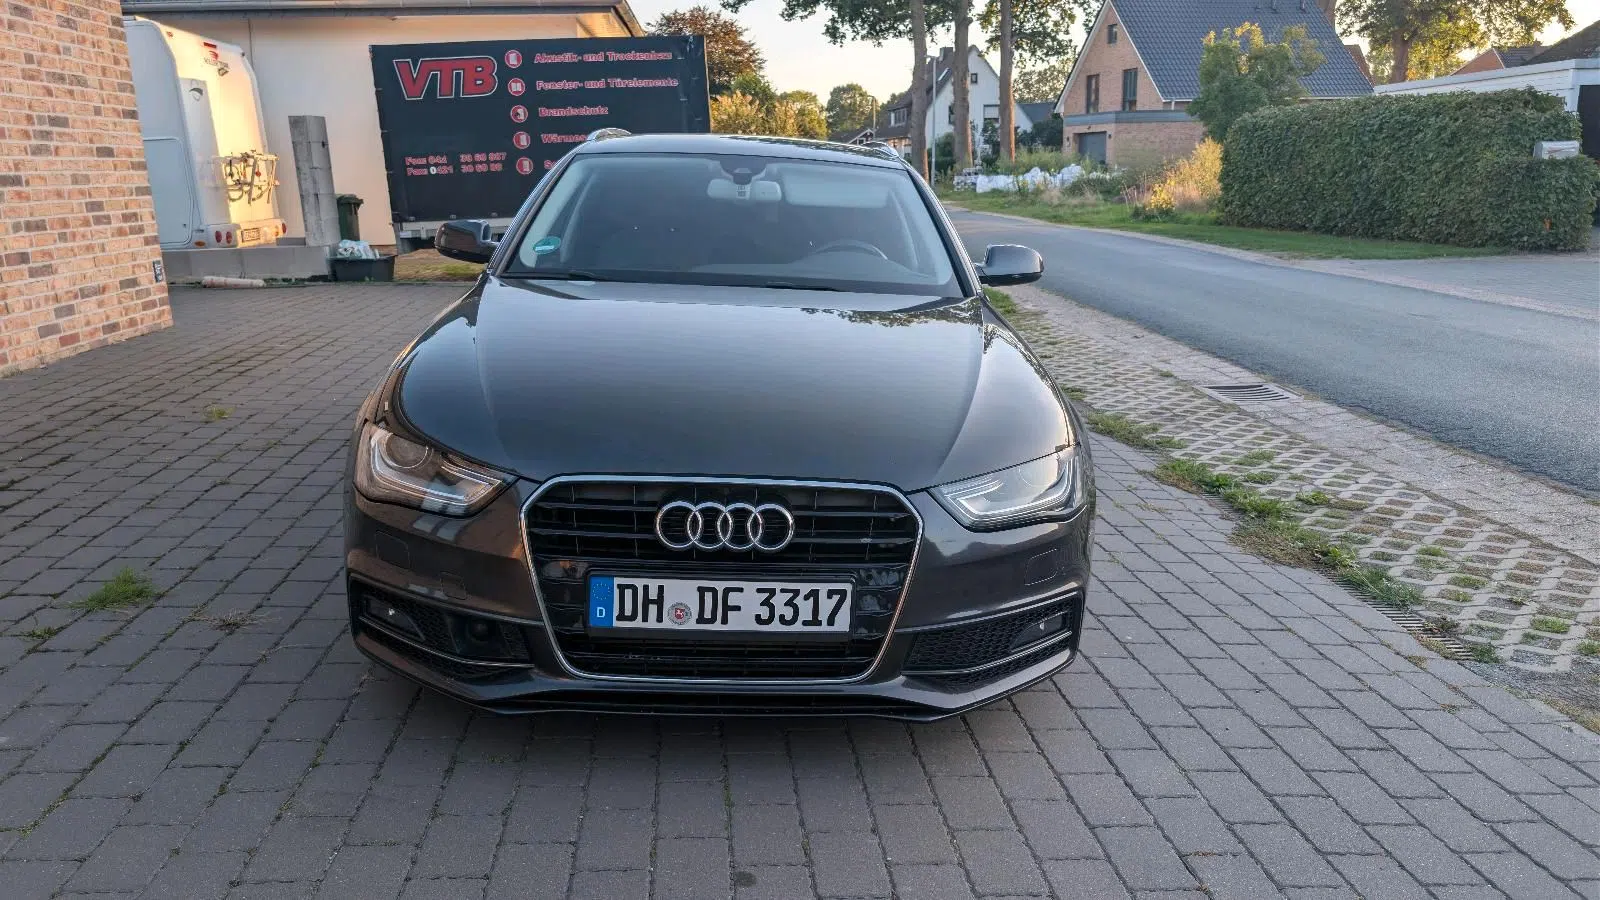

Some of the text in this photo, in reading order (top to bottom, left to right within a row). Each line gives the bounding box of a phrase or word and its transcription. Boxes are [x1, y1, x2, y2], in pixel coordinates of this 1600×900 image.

[583, 51, 605, 62] und
[393, 55, 498, 100] VTB
[536, 77, 679, 90] Fenster- und Türelemente
[538, 105, 609, 117] Brandschutz
[541, 132, 588, 144] Wärmes
[596, 607, 605, 618] D
[615, 583, 665, 623] DH
[695, 586, 744, 625] DF
[754, 587, 848, 627] 3317
